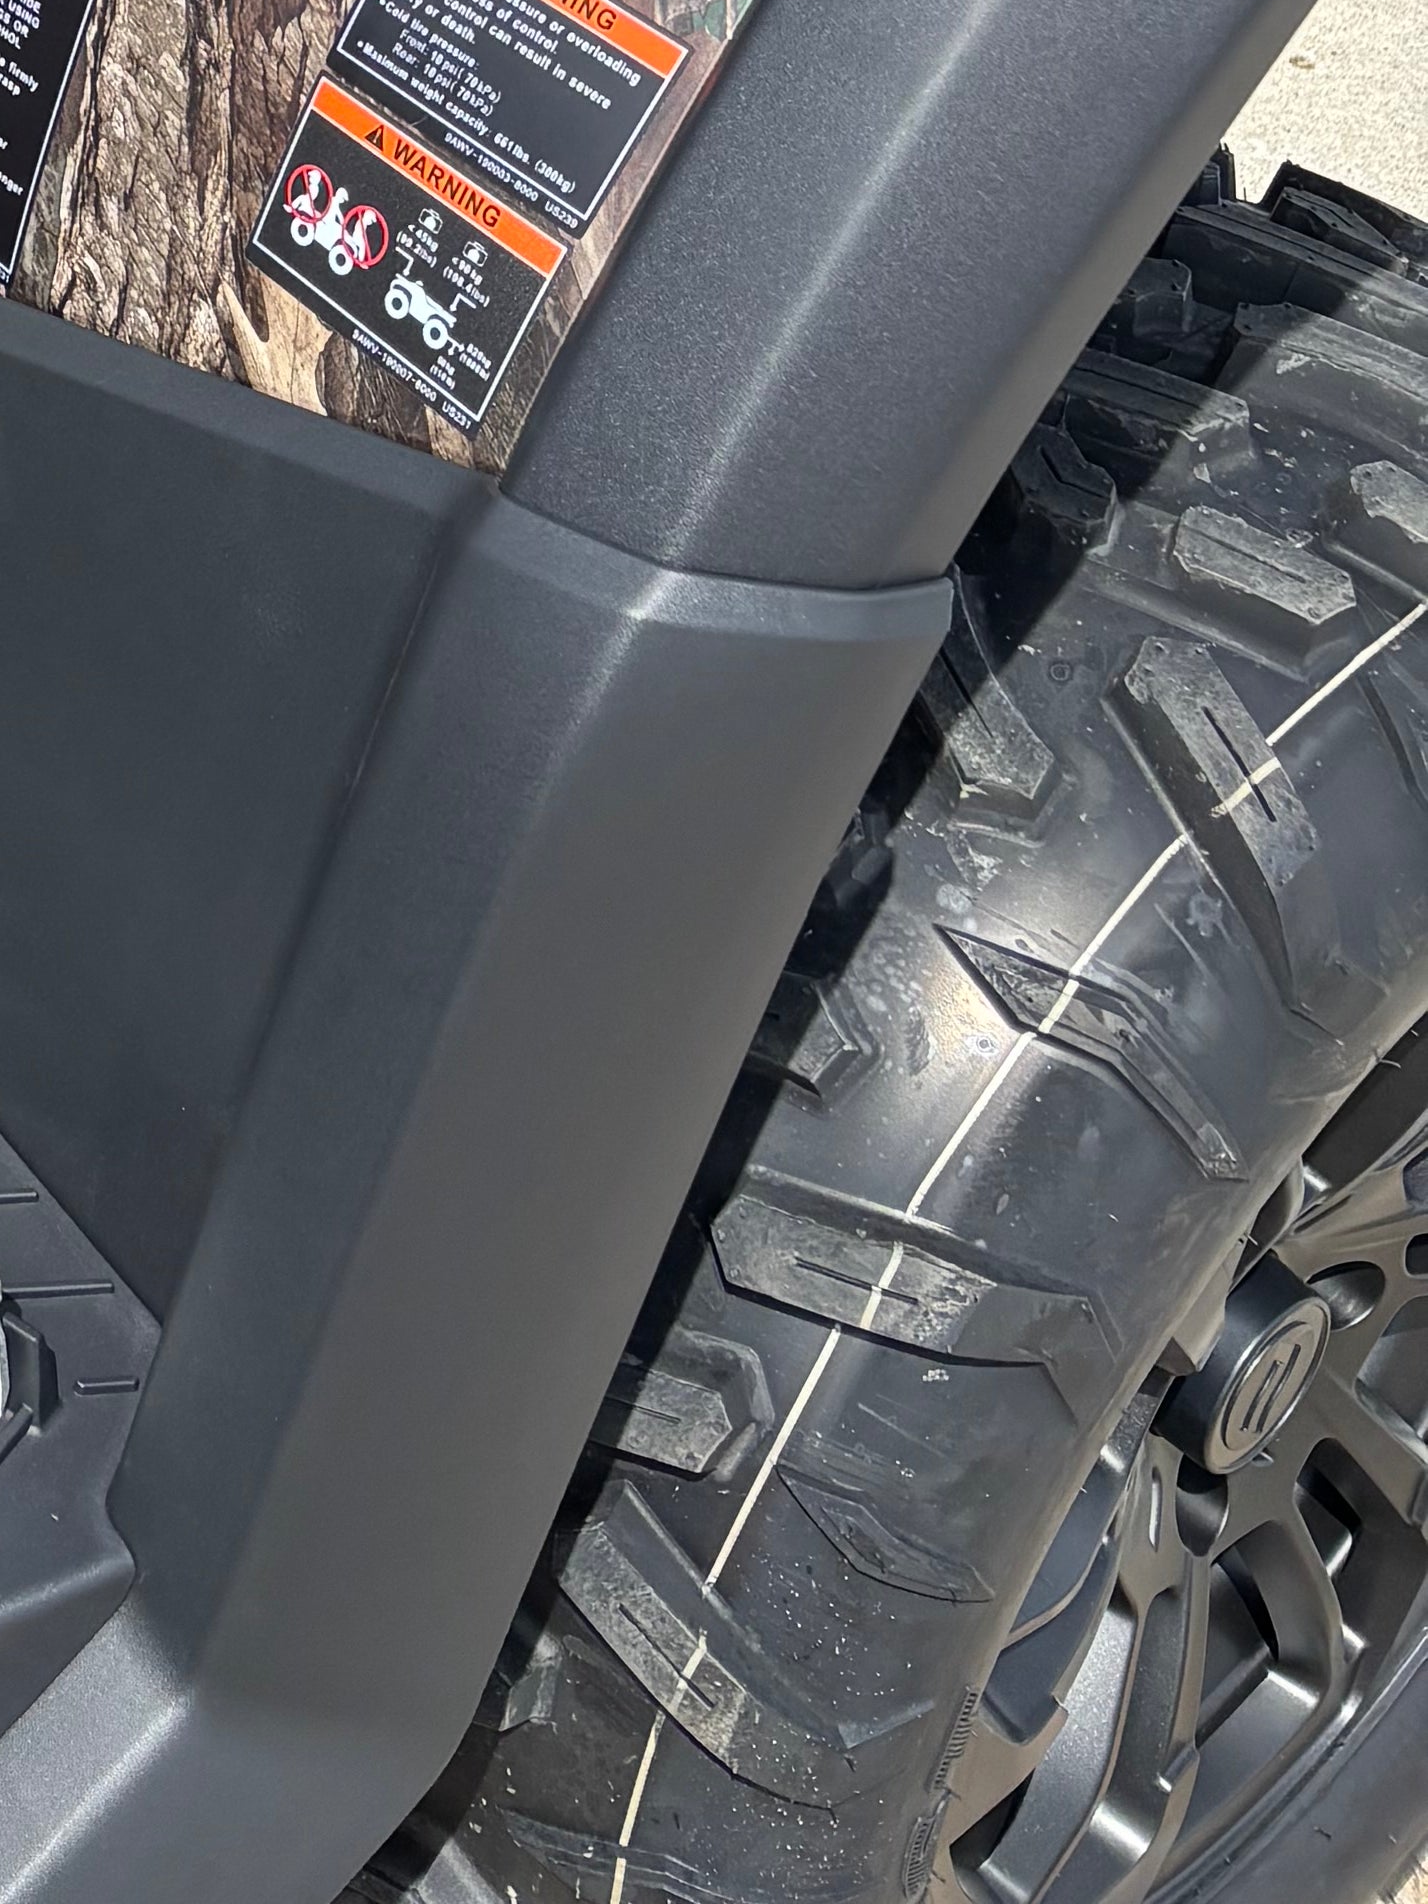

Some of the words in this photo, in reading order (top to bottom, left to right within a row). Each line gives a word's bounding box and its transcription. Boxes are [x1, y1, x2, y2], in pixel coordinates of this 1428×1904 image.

[8, 0, 39, 28] USING
[13, 19, 28, 37] OR
[385, 1, 410, 23] Cold
[410, 17, 429, 36] tire
[428, 33, 478, 69] pressure:
[424, 4, 440, 17] or
[440, 14, 474, 43] death.
[495, 8, 512, 22] of
[512, 18, 558, 53] control.
[488, 25, 511, 45] can
[513, 41, 551, 70] result
[552, 63, 566, 80] in
[568, 76, 611, 109] severe
[548, 20, 565, 34] or
[566, 32, 640, 86] overloading
[8, 61, 38, 91] firmly
[394, 140, 499, 226] WARNING
[544, 200, 578, 228] US239
